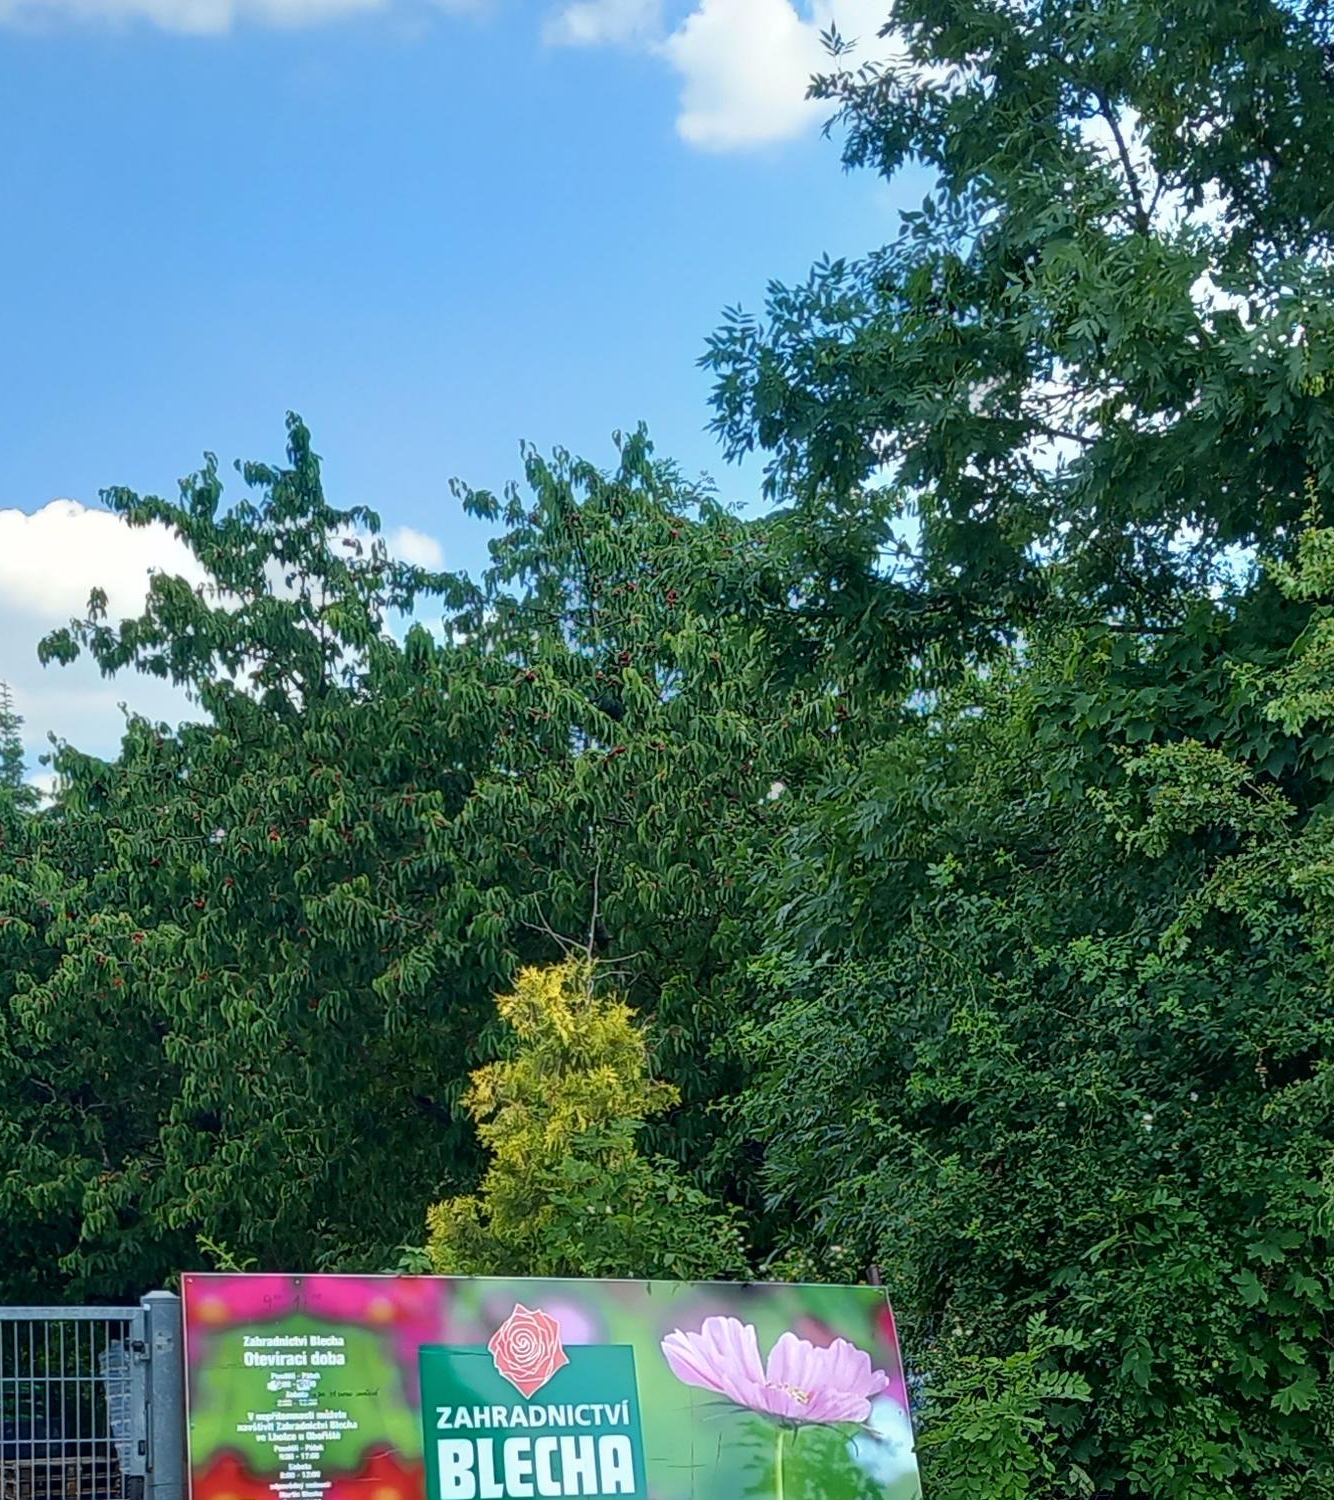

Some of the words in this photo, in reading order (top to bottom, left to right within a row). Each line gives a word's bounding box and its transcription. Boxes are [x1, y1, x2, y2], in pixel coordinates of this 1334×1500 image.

[310, 1335, 345, 1347] Blecha
[310, 1350, 346, 1366] doba
[435, 1399, 630, 1430] ZAHRADNICTVÍ
[436, 1434, 636, 1500] BLECHA
